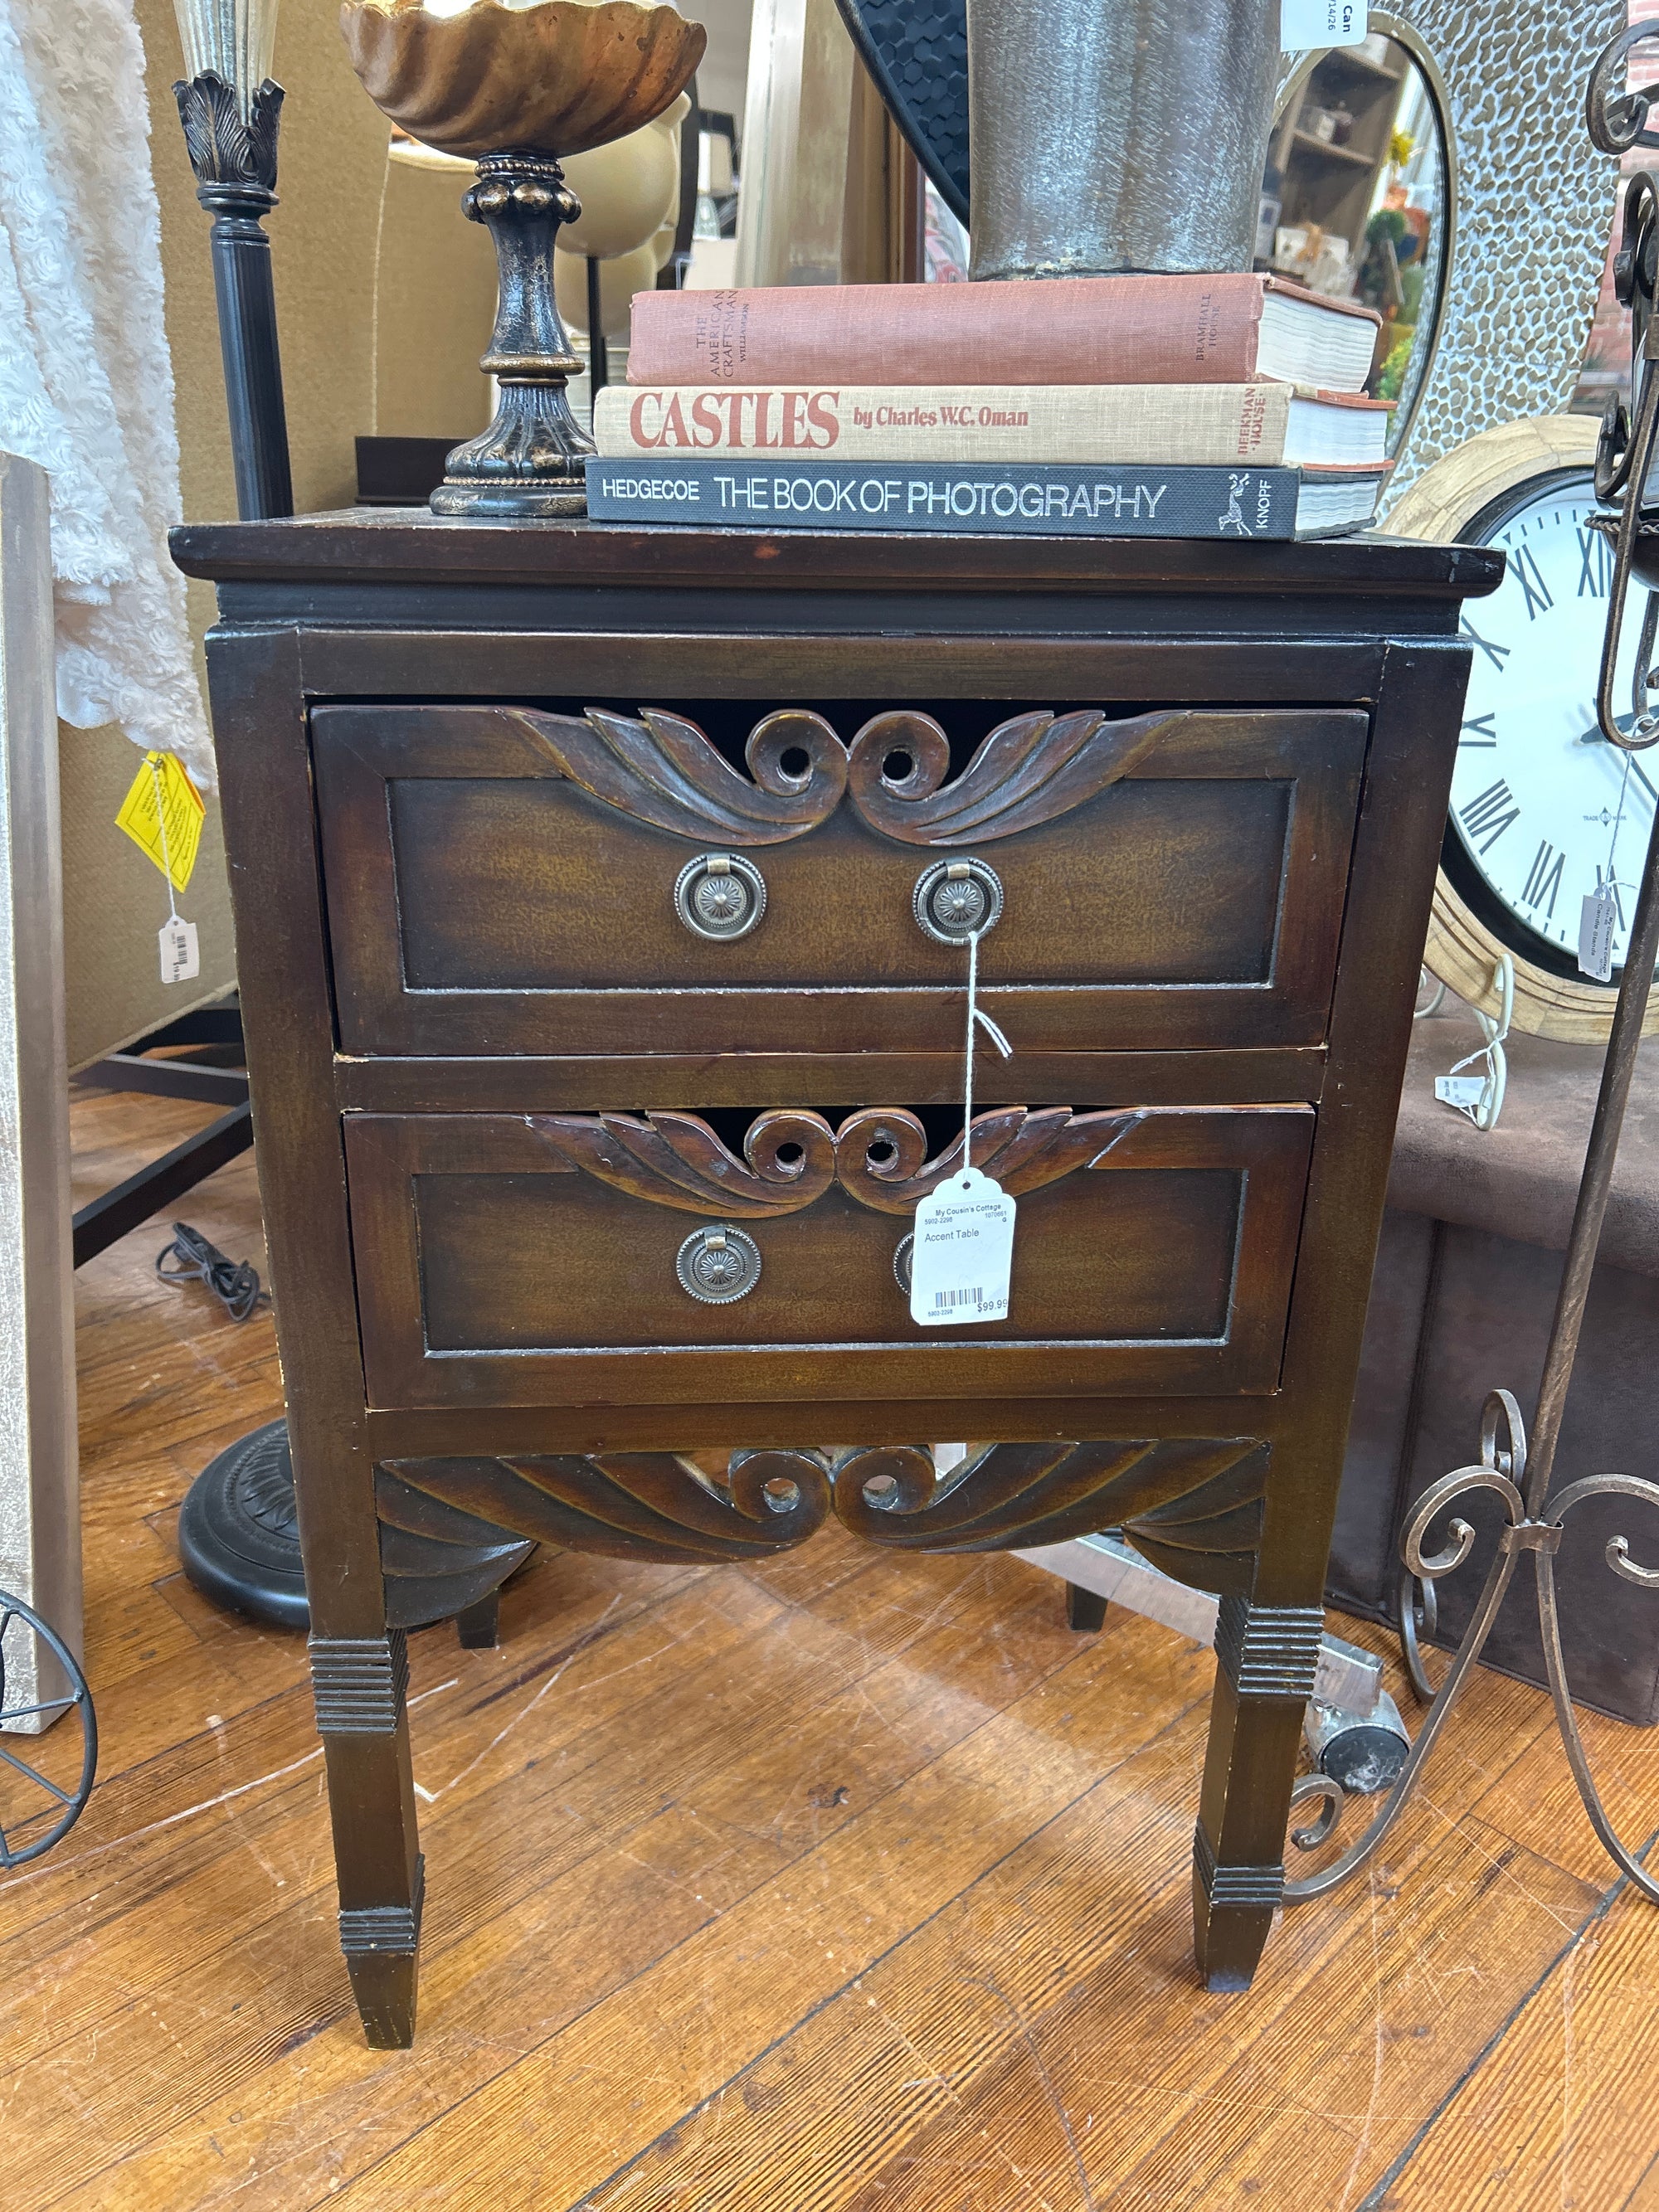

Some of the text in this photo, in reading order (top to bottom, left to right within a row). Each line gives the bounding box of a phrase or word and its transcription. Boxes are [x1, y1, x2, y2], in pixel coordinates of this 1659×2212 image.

[1343, 5, 1353, 32] Can
[696, 318, 707, 348] THE
[708, 290, 725, 377] AMERICAN
[722, 290, 739, 377] CRAFTSMAN
[739, 304, 750, 362] WILLIAMSON
[1195, 294, 1212, 362] BRAMHALL
[1208, 305, 1222, 347] HOUSE
[629, 391, 1029, 450] CASTLES by Charles W.C. Oman
[602, 479, 700, 501] HEDGECOE
[713, 477, 1167, 518] THE BOOK OF PHOTOGRAPHY
[1255, 479, 1272, 529] KNOPF
[1593, 903, 1603, 930] Candle
[1590, 931, 1599, 956] Stands
[935, 1203, 1002, 1218] My Cousin's Cottage
[924, 1228, 980, 1242] Accent Table
[977, 1298, 1008, 1313] $99.99
